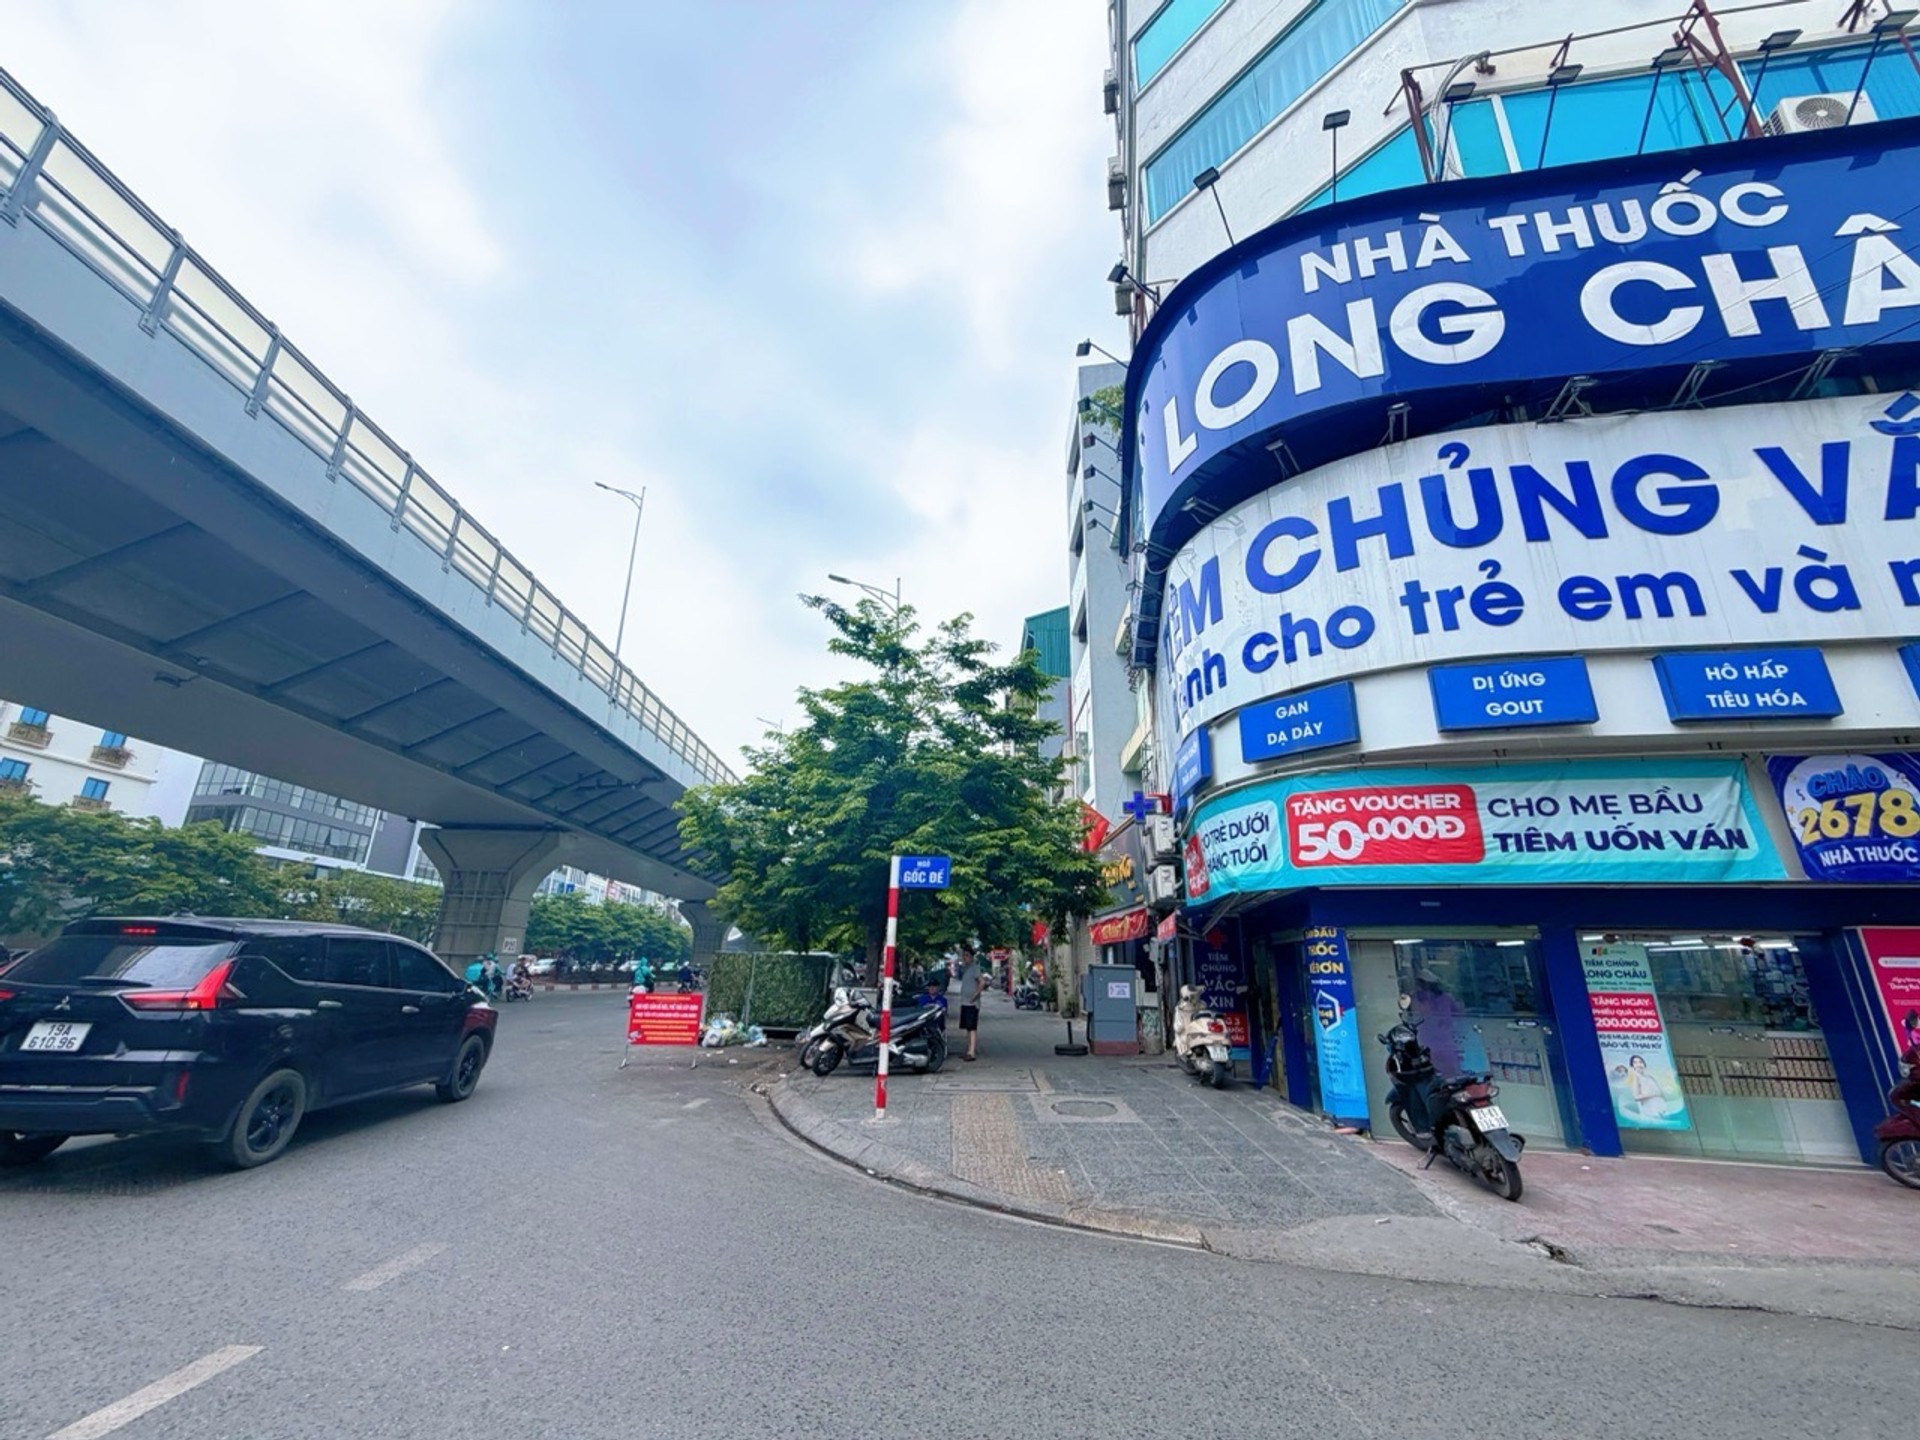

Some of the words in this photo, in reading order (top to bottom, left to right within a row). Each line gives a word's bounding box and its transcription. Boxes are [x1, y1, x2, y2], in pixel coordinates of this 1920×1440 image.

[1300, 212, 1471, 293] NHÀ
[1488, 168, 1789, 258] THUỐC
[1162, 281, 1506, 474] LONG
[1579, 212, 1920, 346] CHÂ
[1245, 441, 1721, 594] CHỦNG
[1241, 604, 1376, 673] cho
[1399, 558, 1525, 635] trẻ
[1557, 569, 1707, 621] em
[1728, 544, 1862, 614] và
[1472, 676, 1495, 694] DỊ
[1498, 671, 1546, 689] ỨNG
[1704, 662, 1739, 681] HÔ
[1744, 658, 1789, 680] HẤP
[1275, 701, 1309, 719] GAN
[1485, 699, 1544, 716] GOUT
[1705, 689, 1750, 708] TIÊU
[1755, 687, 1808, 706] HÓA
[1266, 729, 1288, 747] DẠ
[1291, 721, 1323, 741] DÀY
[1806, 763, 1892, 798] CHÀO
[1290, 796, 1347, 819] TẶNG
[1348, 793, 1461, 812] VOUCHER
[1487, 796, 1560, 818] CHO
[1568, 794, 1623, 820] MẸ
[1628, 785, 1704, 815] BẦU
[1228, 811, 1270, 840] DƯỚI
[1797, 787, 1920, 847] 2678
[1492, 826, 1578, 853] TIÊM
[1584, 821, 1666, 852] UỐN
[1669, 822, 1749, 850] VÁN
[1229, 836, 1269, 867] TUỔI
[1819, 844, 1856, 867] NHÀ
[1854, 840, 1919, 863] THUỐC
[1208, 995, 1234, 1009] XIN
[28, 1036, 77, 1050] 610.96
[47, 1023, 74, 1037] 19A
